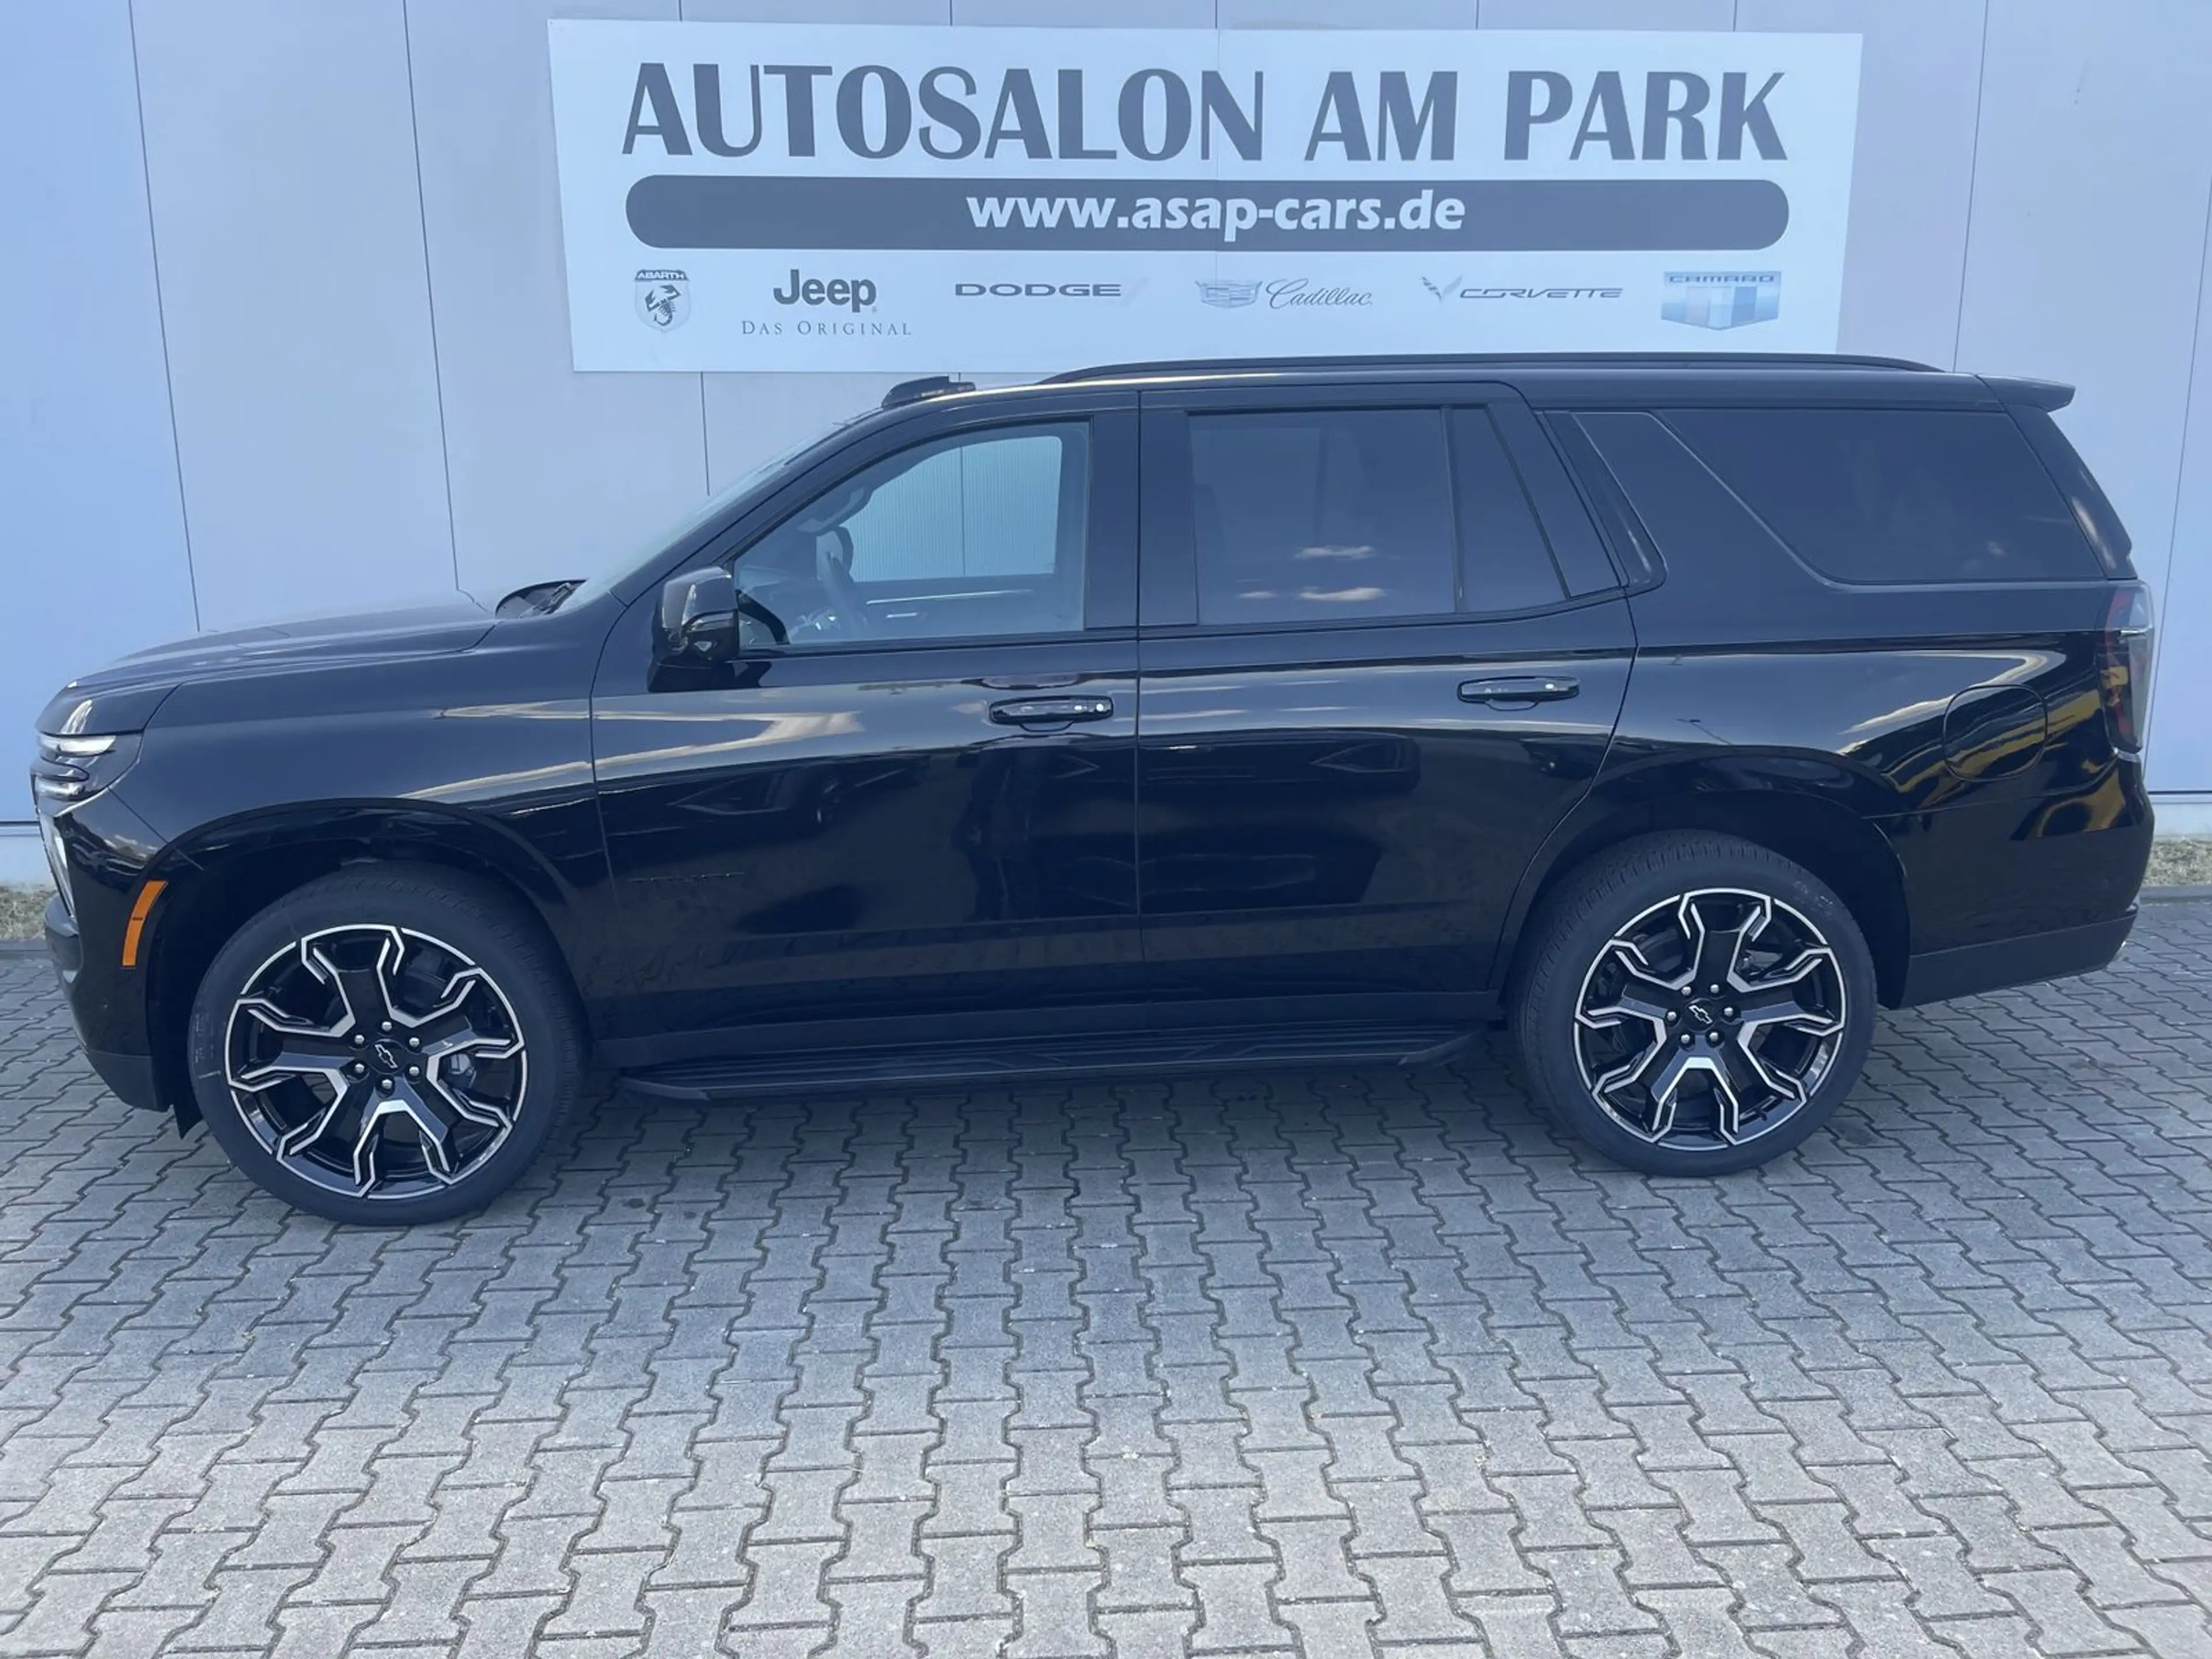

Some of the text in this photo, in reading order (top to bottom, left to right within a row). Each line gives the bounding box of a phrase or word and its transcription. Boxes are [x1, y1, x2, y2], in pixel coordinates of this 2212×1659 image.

[622, 62, 1789, 161] AUTOSALON AM PARK
[966, 189, 1466, 243] www.asap-cars.de
[637, 270, 685, 280] ABARTH
[1669, 275, 1775, 283] CAMARO
[773, 268, 877, 313] Jeep
[955, 283, 1122, 297] DODGE
[1265, 278, 1373, 310] Cadillac
[1460, 287, 1623, 298] CORVETTE
